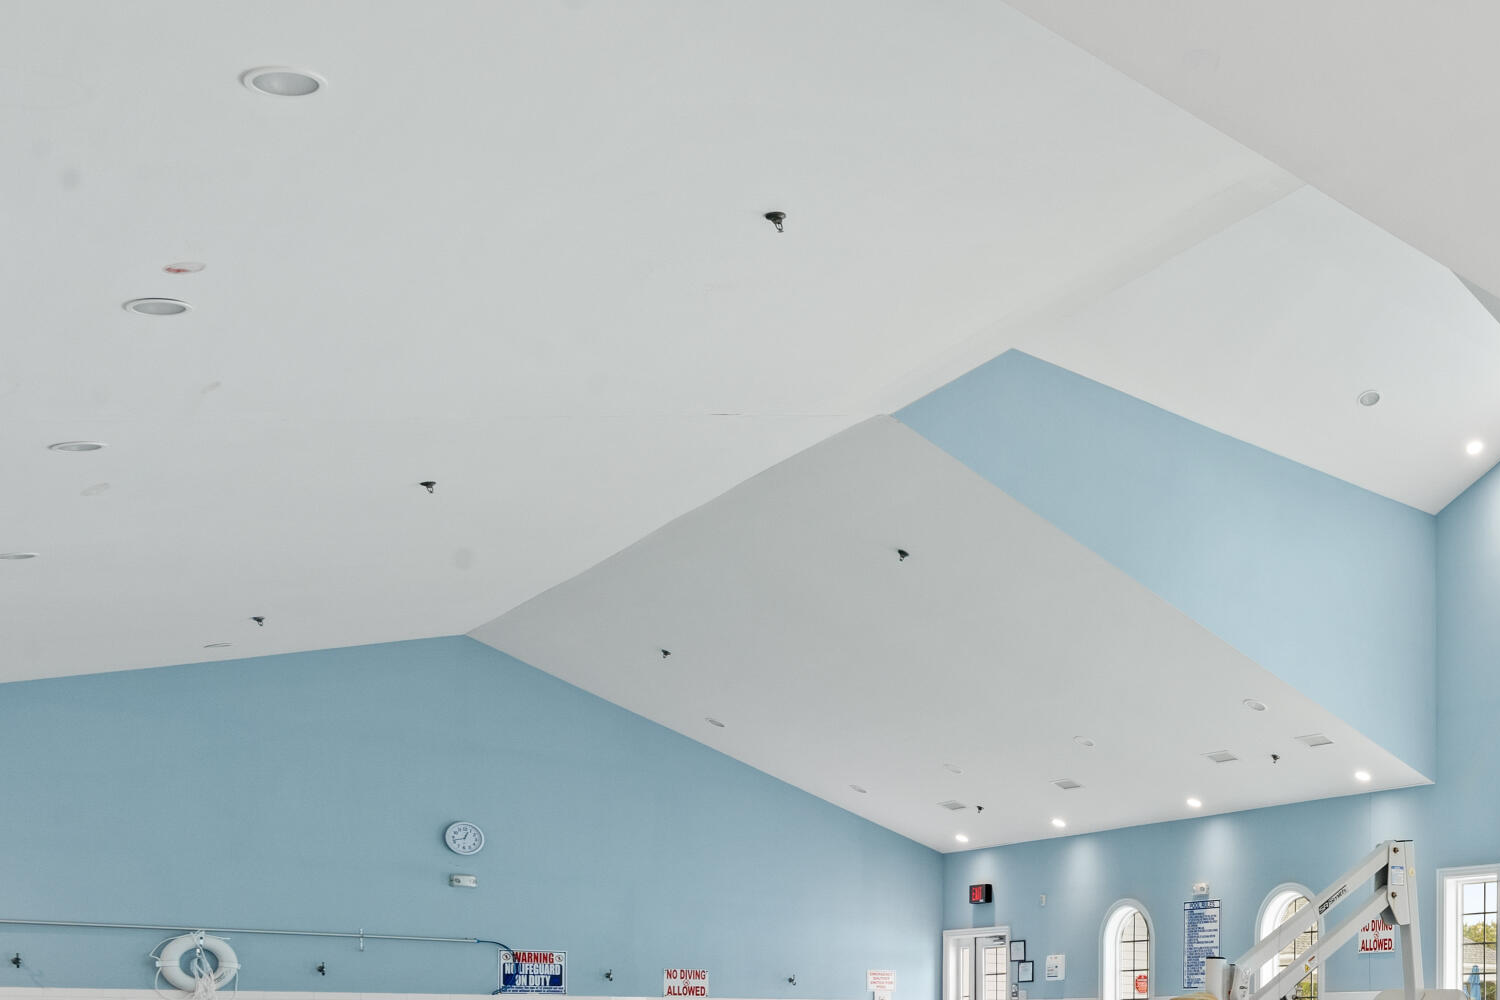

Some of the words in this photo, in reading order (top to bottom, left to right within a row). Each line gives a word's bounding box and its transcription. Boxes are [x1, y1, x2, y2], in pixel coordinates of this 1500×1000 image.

[1372, 920, 1392, 931] DIVING
[1361, 938, 1393, 952] ALLOWED
[513, 952, 554, 964] WARNING
[518, 964, 560, 975] LIFEGUARD
[666, 970, 678, 980] NO
[680, 970, 706, 980] DIVING
[528, 975, 551, 986] DUTY
[667, 986, 706, 996] ALLOWED
